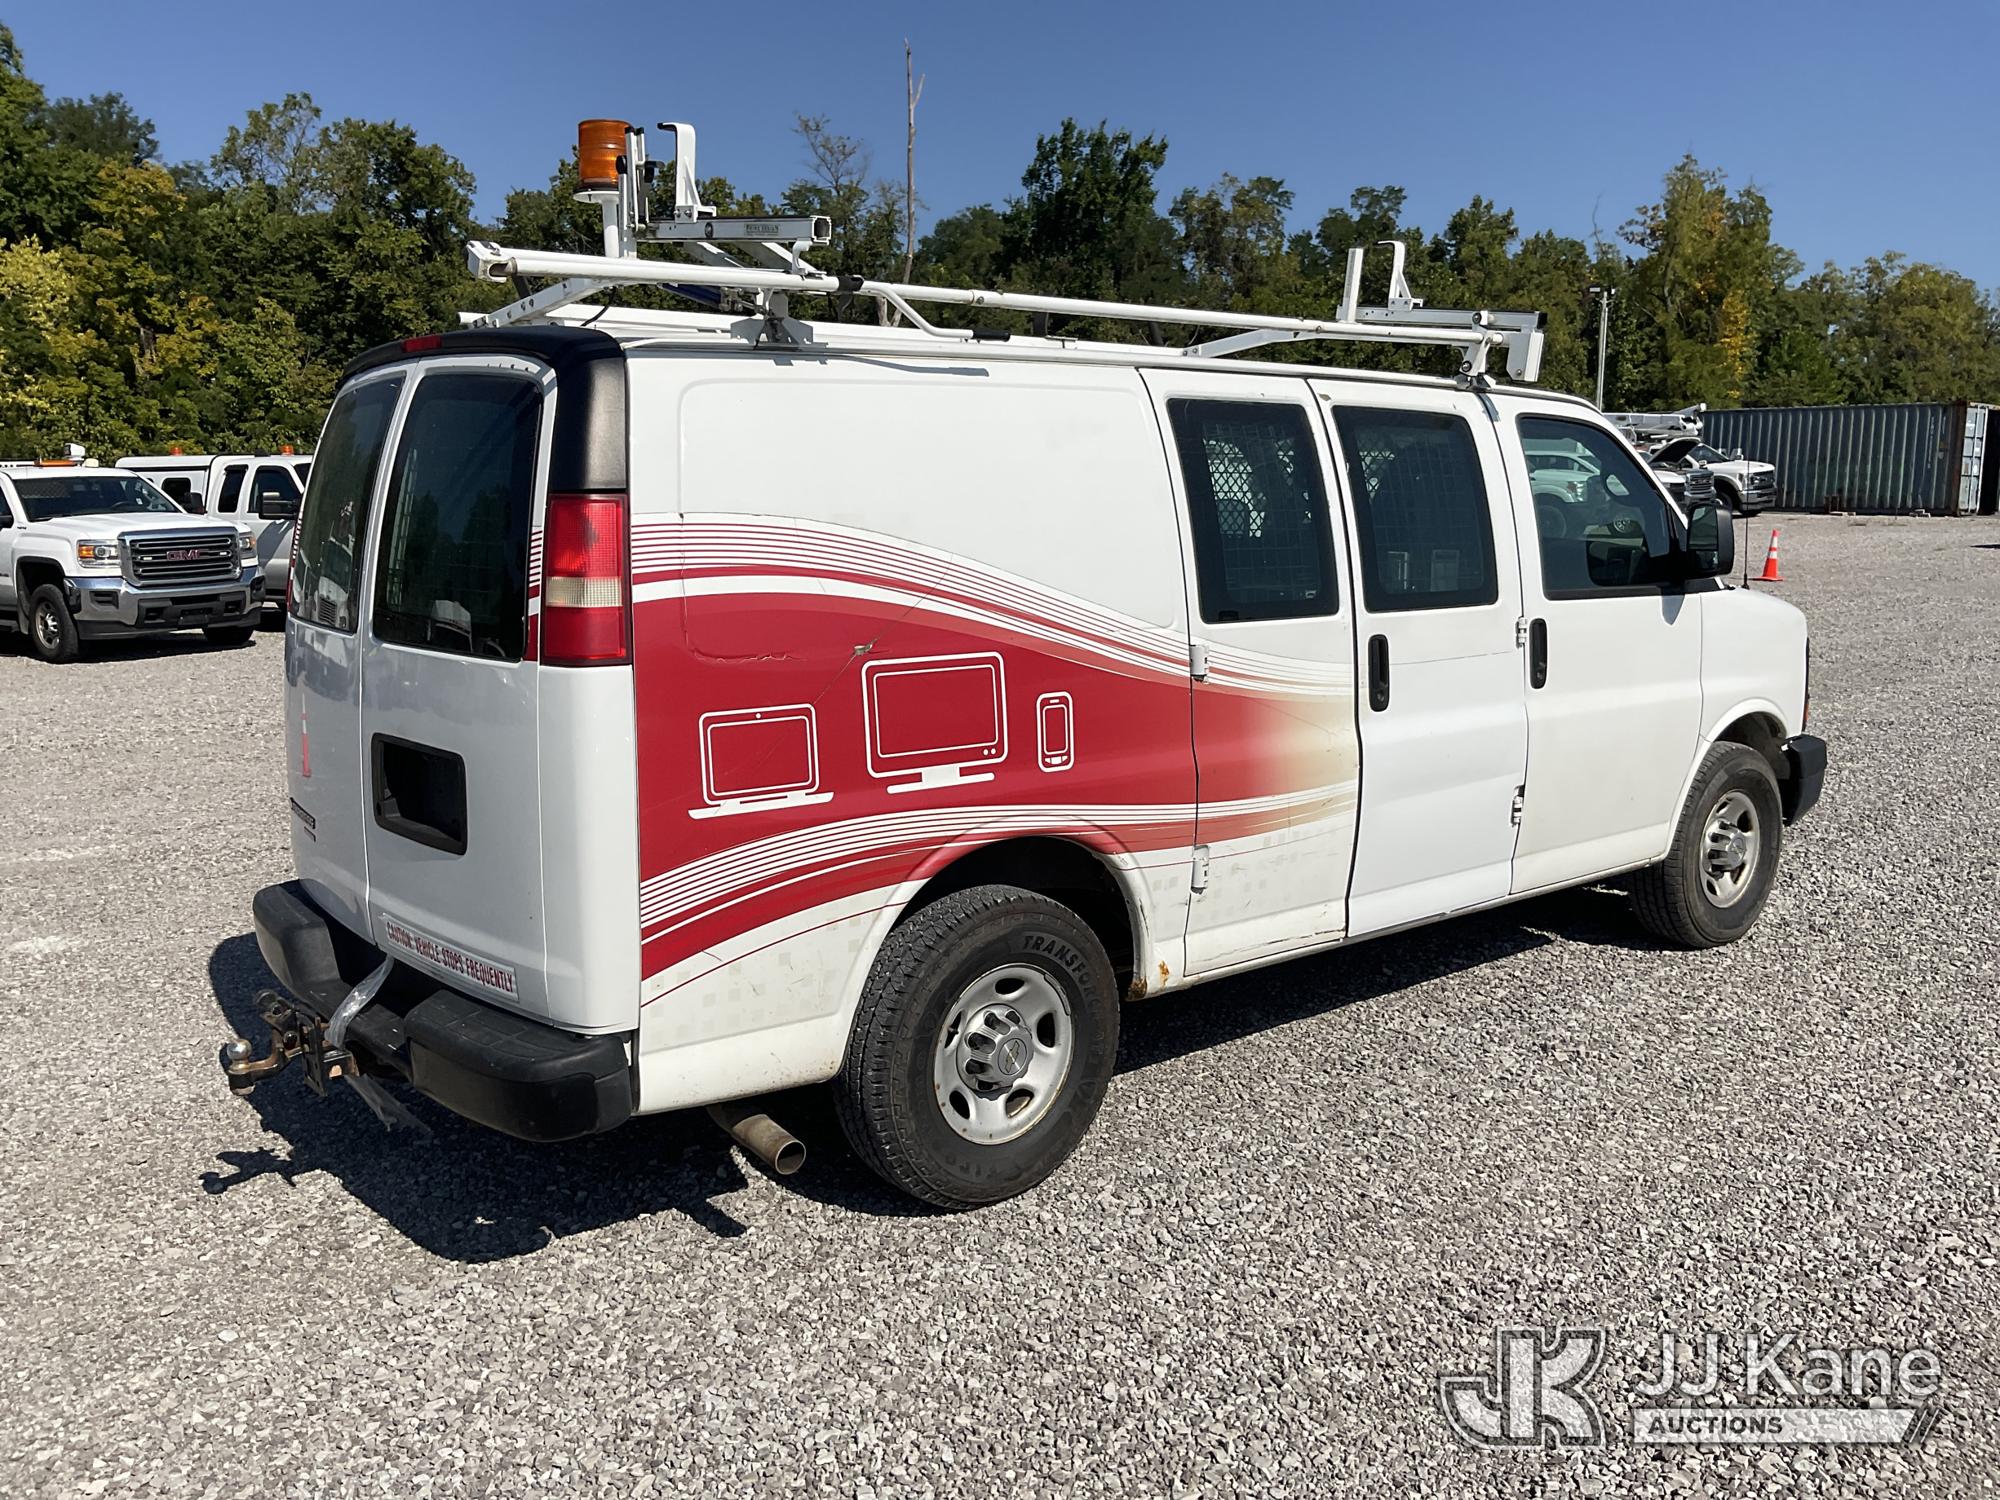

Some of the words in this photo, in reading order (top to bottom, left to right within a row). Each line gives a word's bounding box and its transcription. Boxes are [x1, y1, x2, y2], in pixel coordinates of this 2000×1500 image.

[415, 937, 441, 963] VEHICLE
[441, 947, 464, 973] STOPS
[465, 957, 513, 992] FREQUENTLY
